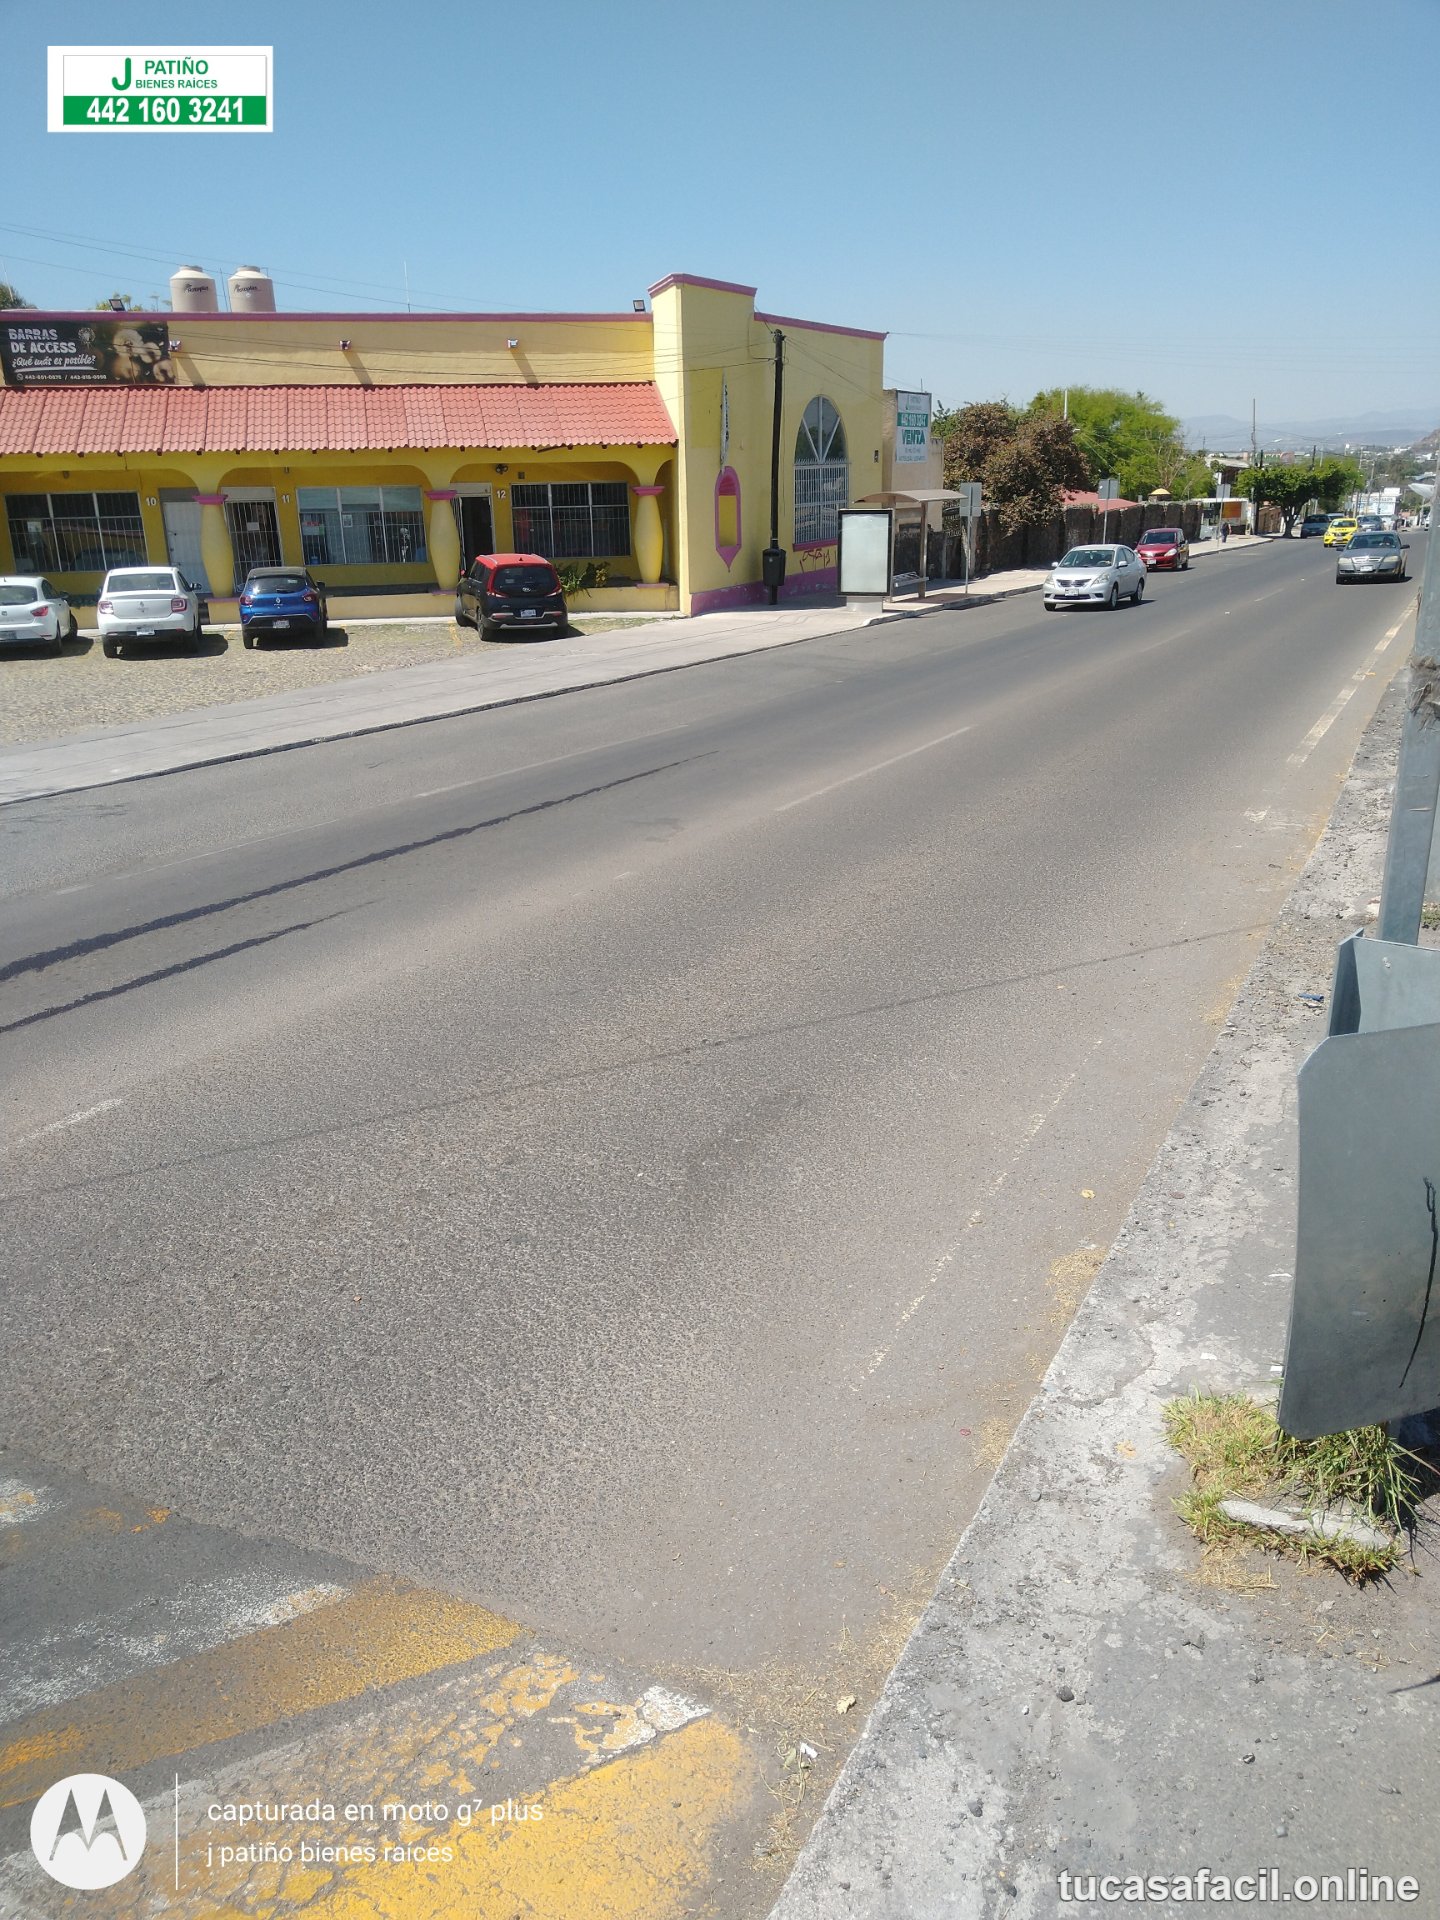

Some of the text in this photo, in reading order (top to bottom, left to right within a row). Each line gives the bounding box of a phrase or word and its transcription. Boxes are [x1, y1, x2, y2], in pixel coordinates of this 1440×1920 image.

[8, 328, 58, 340] BARRAS
[11, 342, 77, 354] DE ACCESS
[53, 356, 63, 366] es
[64, 353, 96, 368] posible?
[902, 429, 926, 445] VENTA
[281, 494, 290, 504] 11
[496, 489, 507, 499] 12
[145, 497, 157, 506] 10
